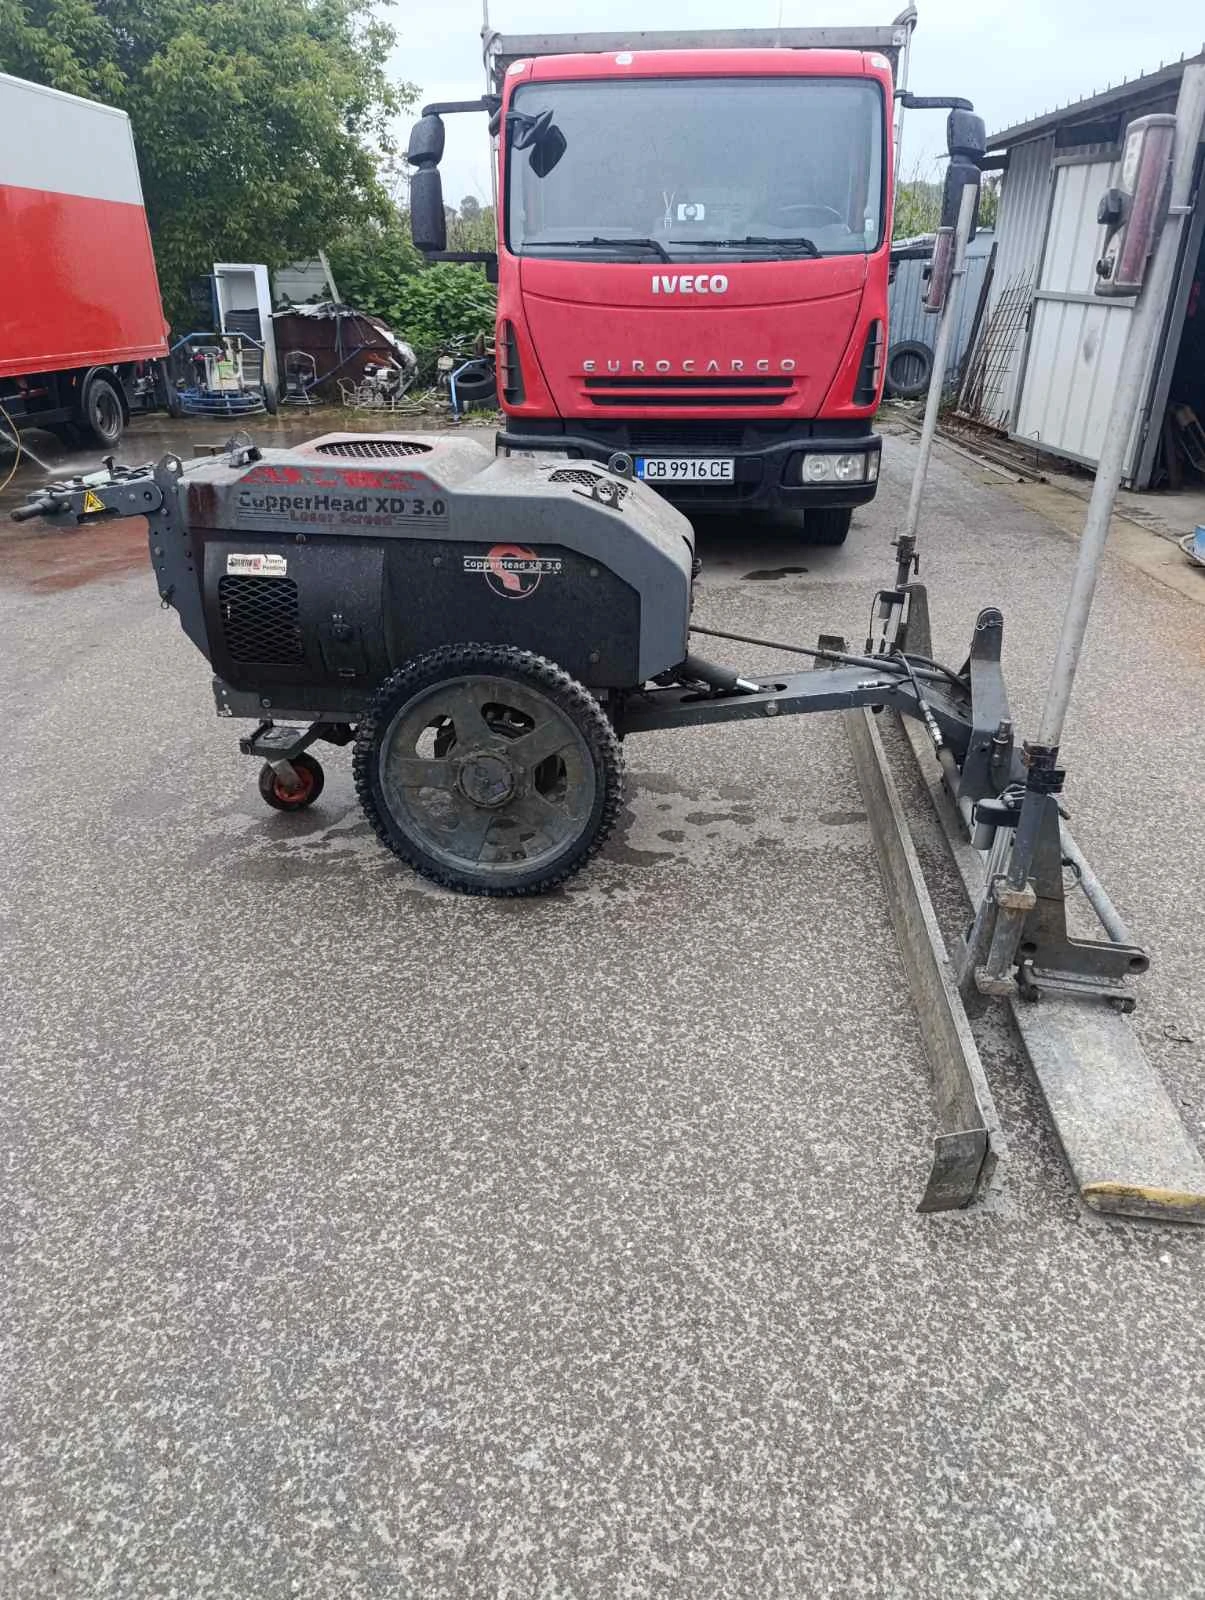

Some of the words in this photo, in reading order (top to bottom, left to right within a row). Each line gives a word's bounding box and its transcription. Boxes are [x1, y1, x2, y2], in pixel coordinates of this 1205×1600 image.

[652, 275, 728, 293] IVECO
[583, 359, 796, 371] EUROCARGO
[647, 461, 667, 477] CB
[670, 461, 707, 477] 9916
[710, 461, 731, 477] CE
[239, 491, 368, 513] CopperHead
[375, 497, 405, 514] XD
[412, 499, 446, 516] 3.0
[463, 559, 526, 571] CopperHead
[545, 561, 562, 571] 3.0
